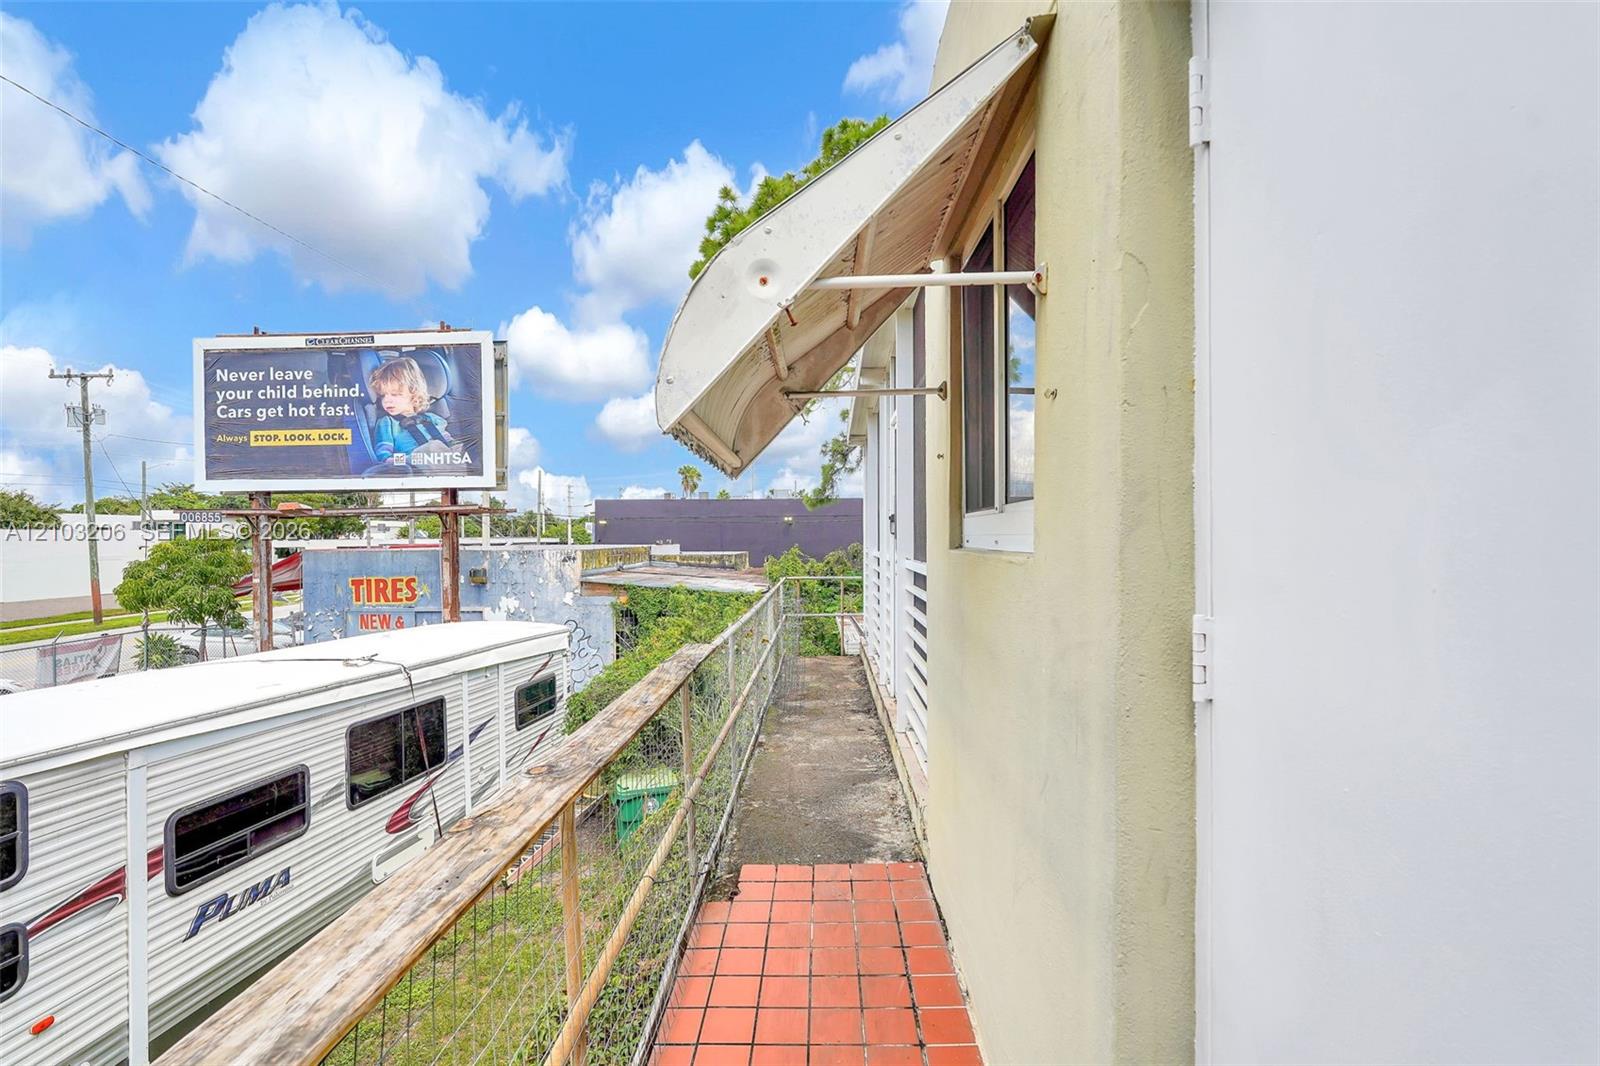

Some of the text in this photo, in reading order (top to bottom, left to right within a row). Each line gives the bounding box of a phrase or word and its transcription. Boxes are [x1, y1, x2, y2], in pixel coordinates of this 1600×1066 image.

[216, 367, 313, 382] Never leave
[215, 383, 365, 402] your child behind.
[216, 402, 355, 421] Cars get hot fast.
[216, 432, 349, 443] Always STOP. LOOK. LOCK.
[423, 452, 472, 465] NHTSA
[181, 512, 221, 522] 006855
[349, 577, 419, 604] TIRES
[359, 613, 405, 630] NEW &
[182, 866, 291, 943] PUMA
